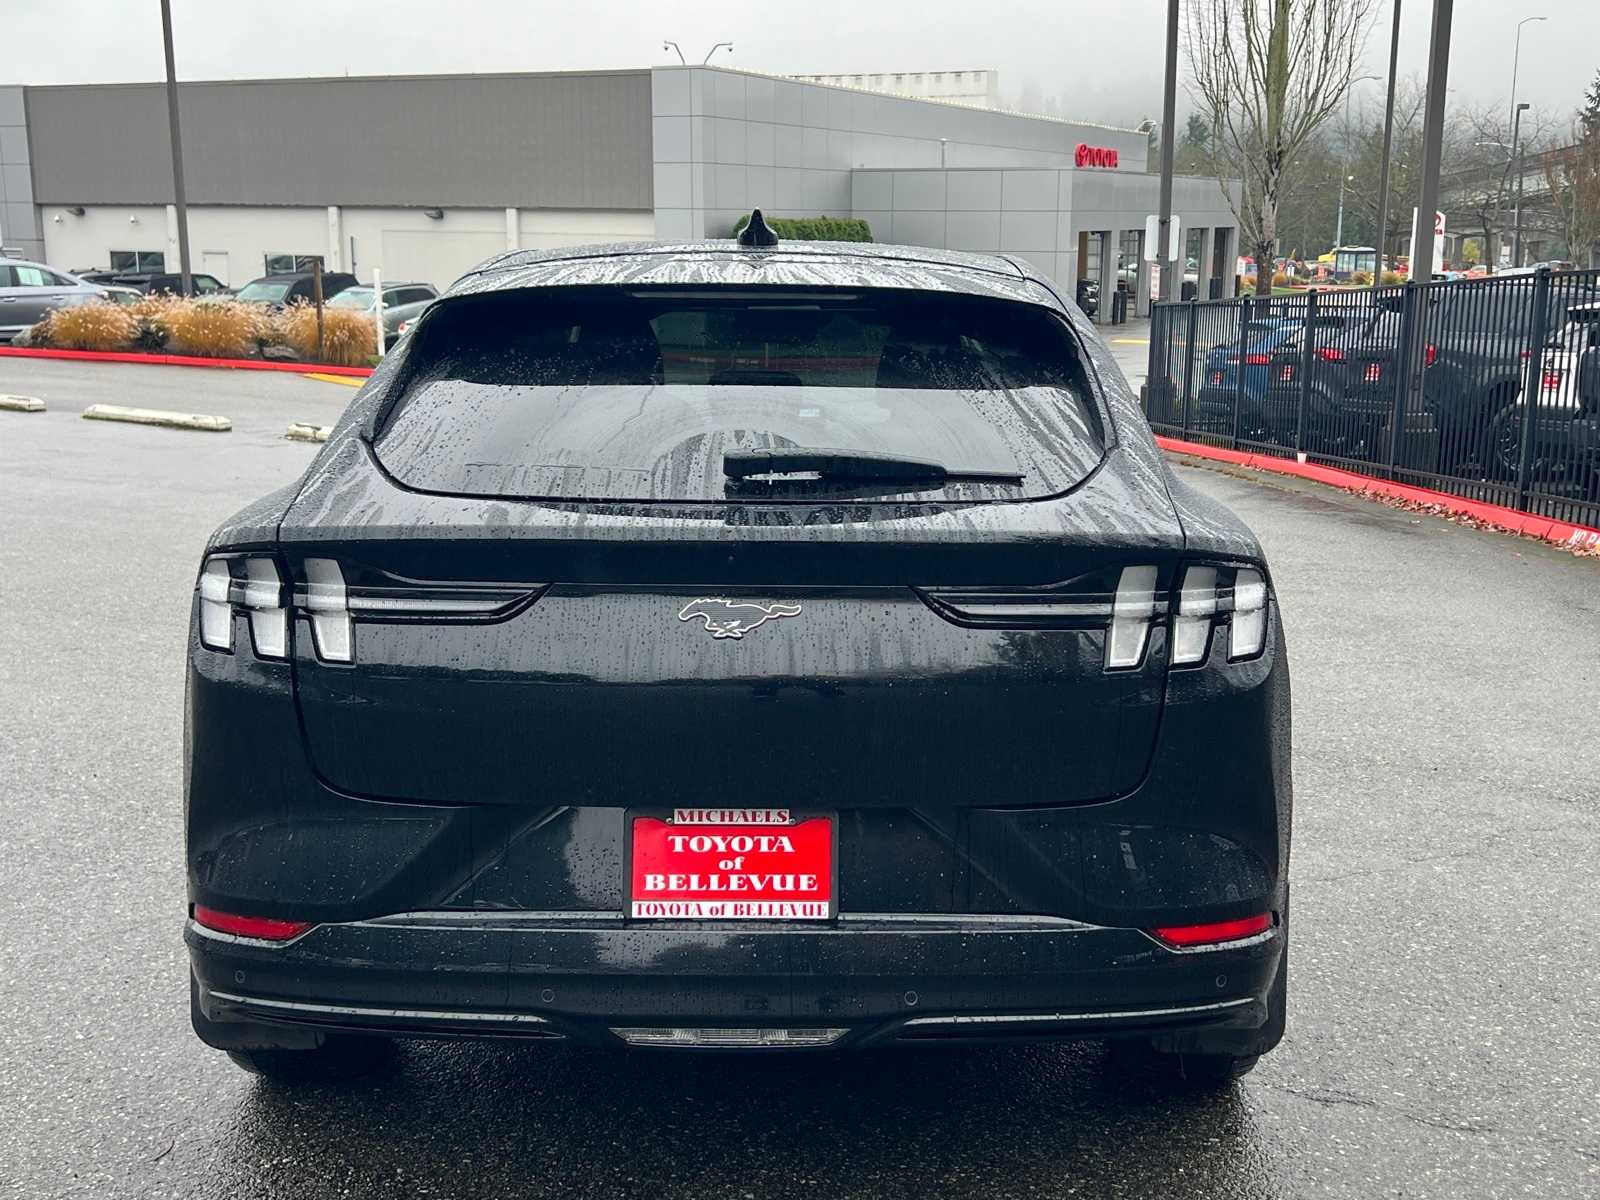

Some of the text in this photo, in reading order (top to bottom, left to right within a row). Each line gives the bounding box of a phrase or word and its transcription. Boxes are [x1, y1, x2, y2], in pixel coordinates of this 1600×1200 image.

[676, 809, 788, 824] MICHAELS
[667, 835, 794, 853] TOYOTA
[718, 856, 745, 871] of
[644, 873, 818, 891] BELLEVUE
[633, 902, 827, 917] TOYOTA of BELLEVUE
